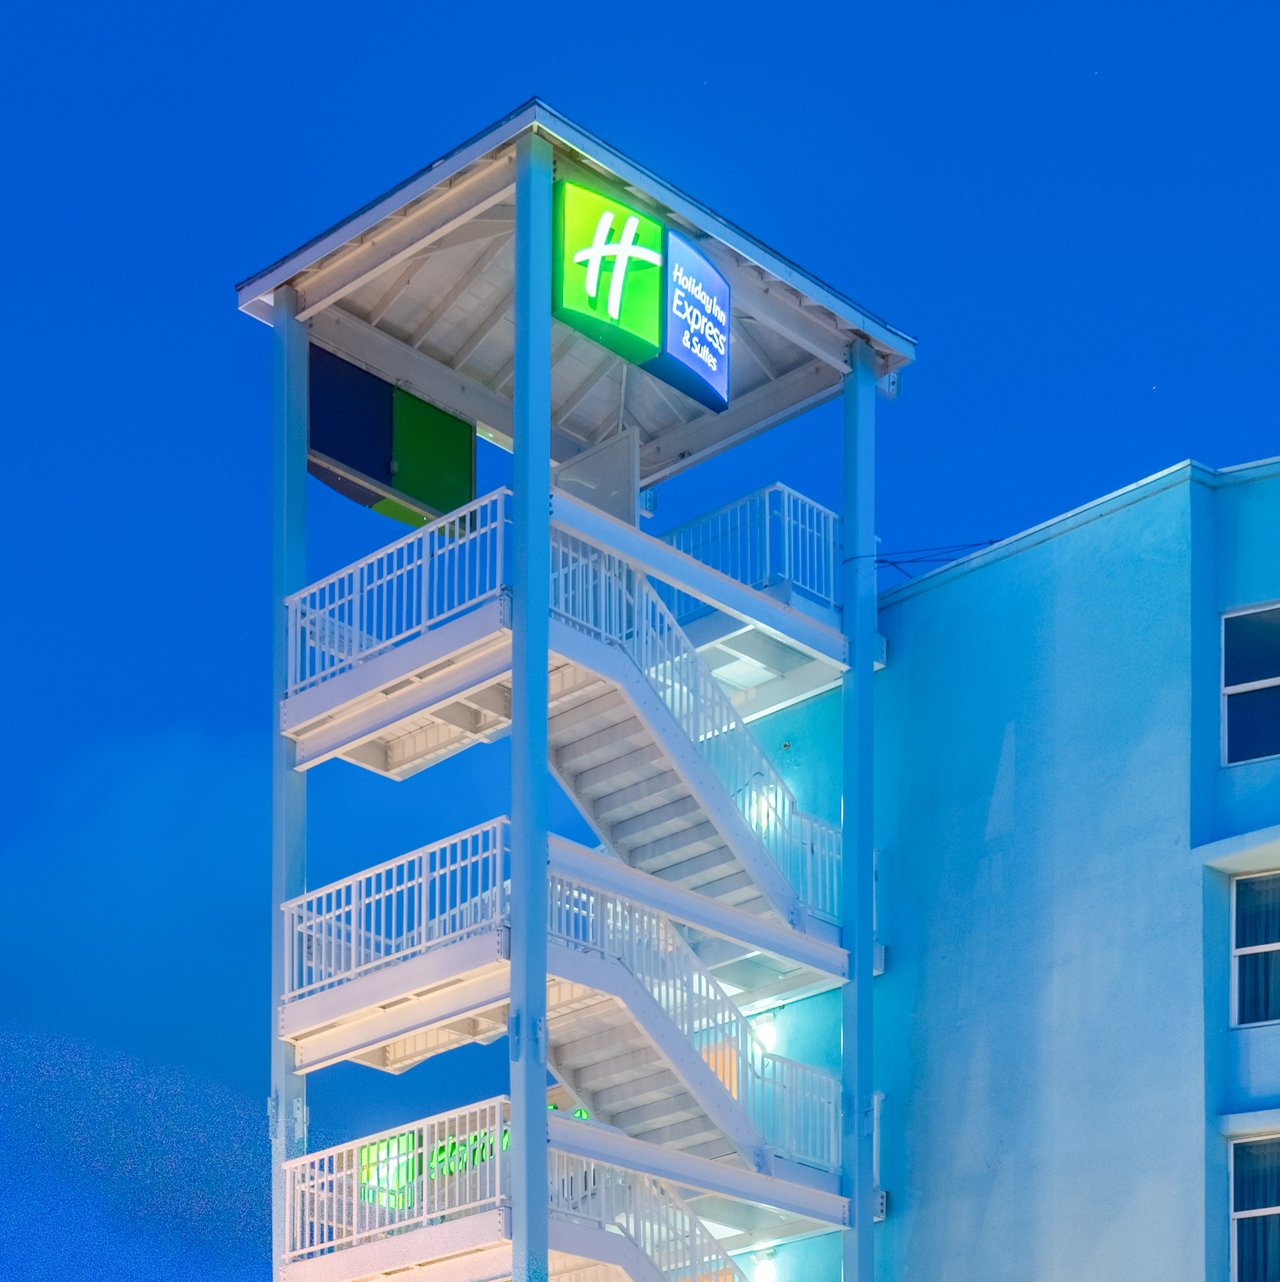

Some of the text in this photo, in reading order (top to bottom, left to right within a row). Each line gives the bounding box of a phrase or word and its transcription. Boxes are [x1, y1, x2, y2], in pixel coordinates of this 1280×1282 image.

[672, 263, 726, 326] Holiday Inn
[673, 289, 726, 356] Express
[682, 329, 718, 372] & Suites
